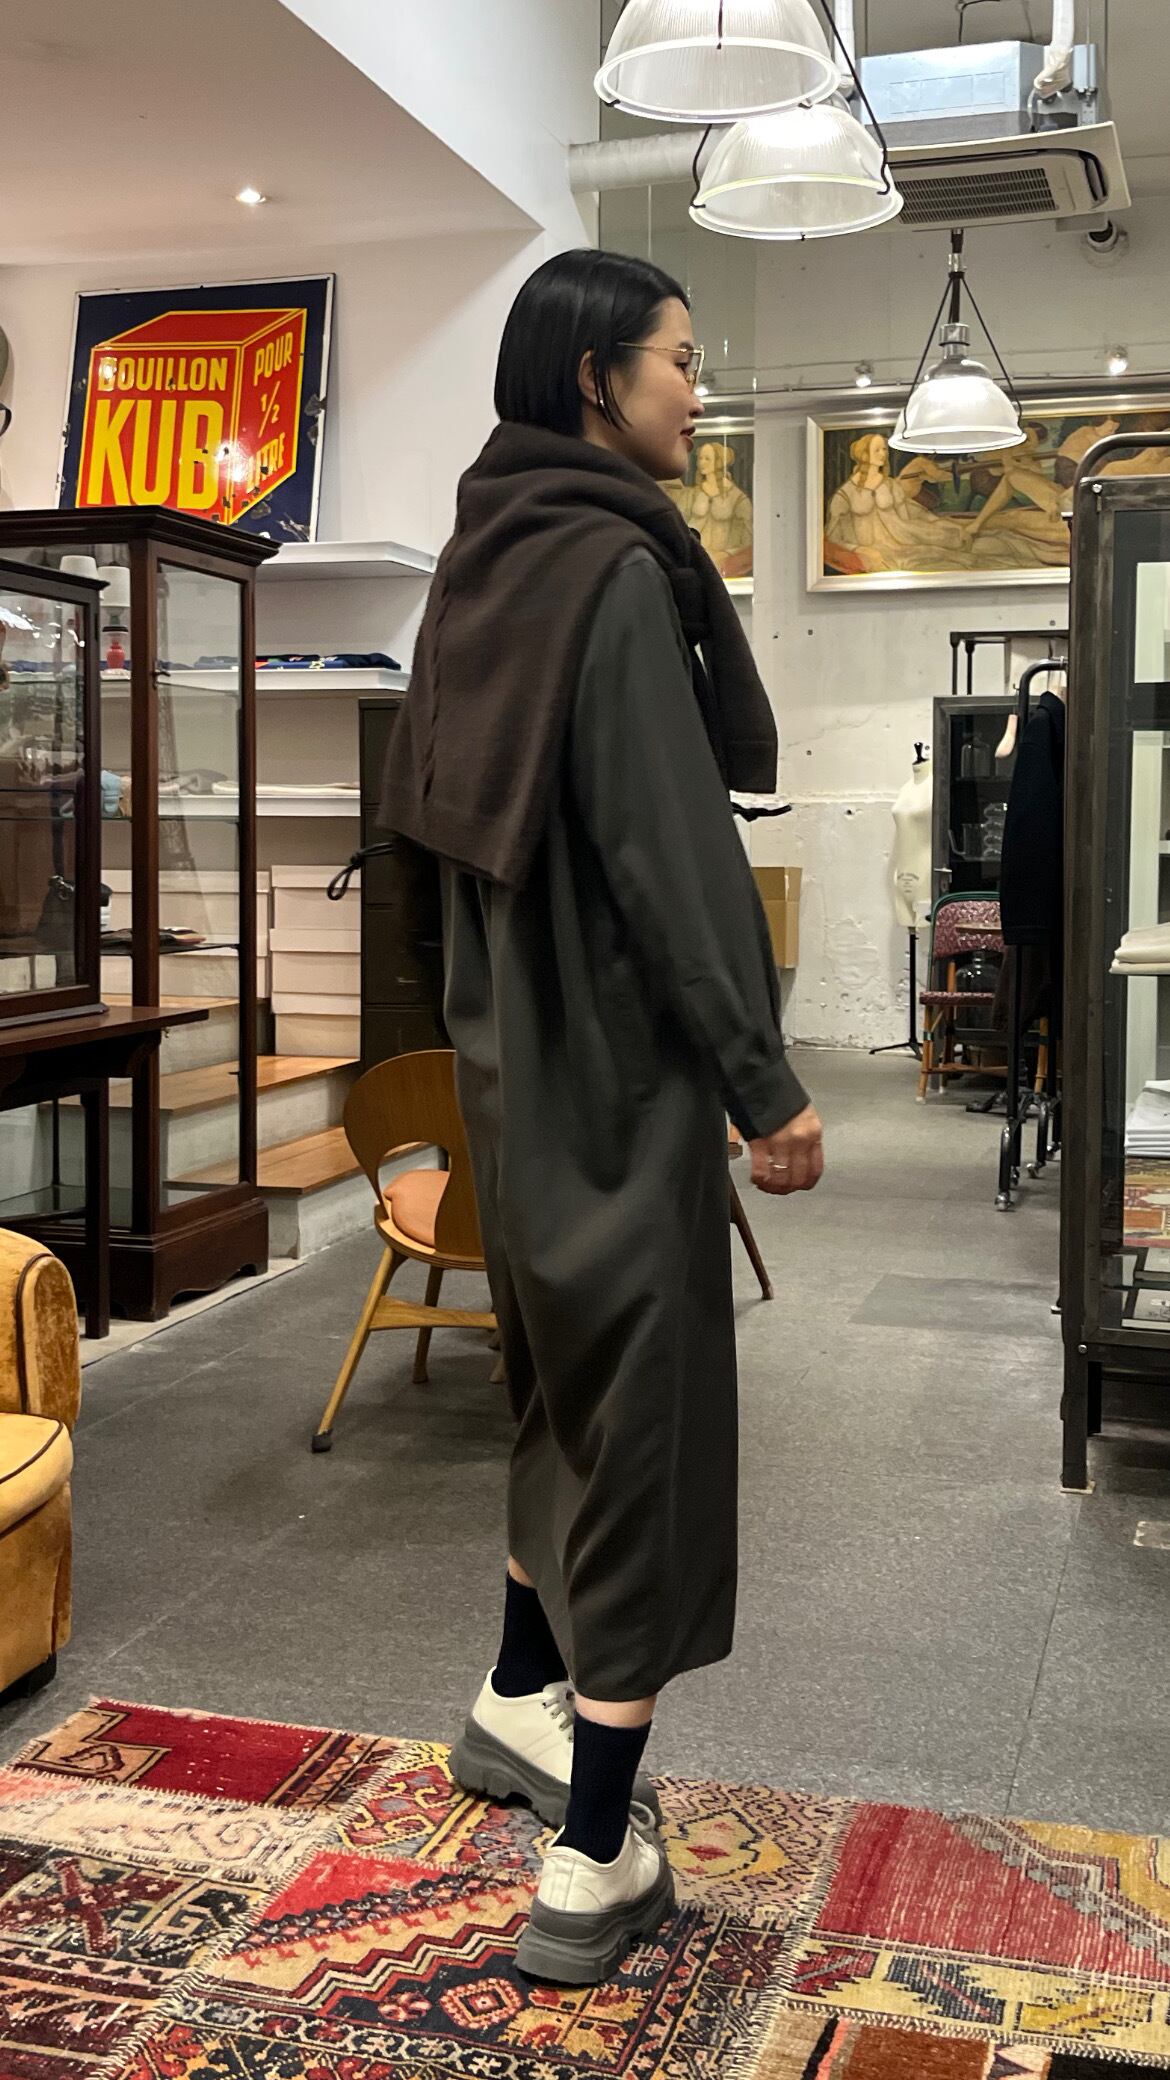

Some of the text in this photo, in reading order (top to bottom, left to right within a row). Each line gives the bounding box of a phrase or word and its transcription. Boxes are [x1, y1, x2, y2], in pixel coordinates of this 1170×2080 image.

[97, 356, 228, 392] BOUILLON
[253, 331, 294, 387] POUR
[257, 380, 281, 438] 1/2
[86, 399, 224, 510] KUB
